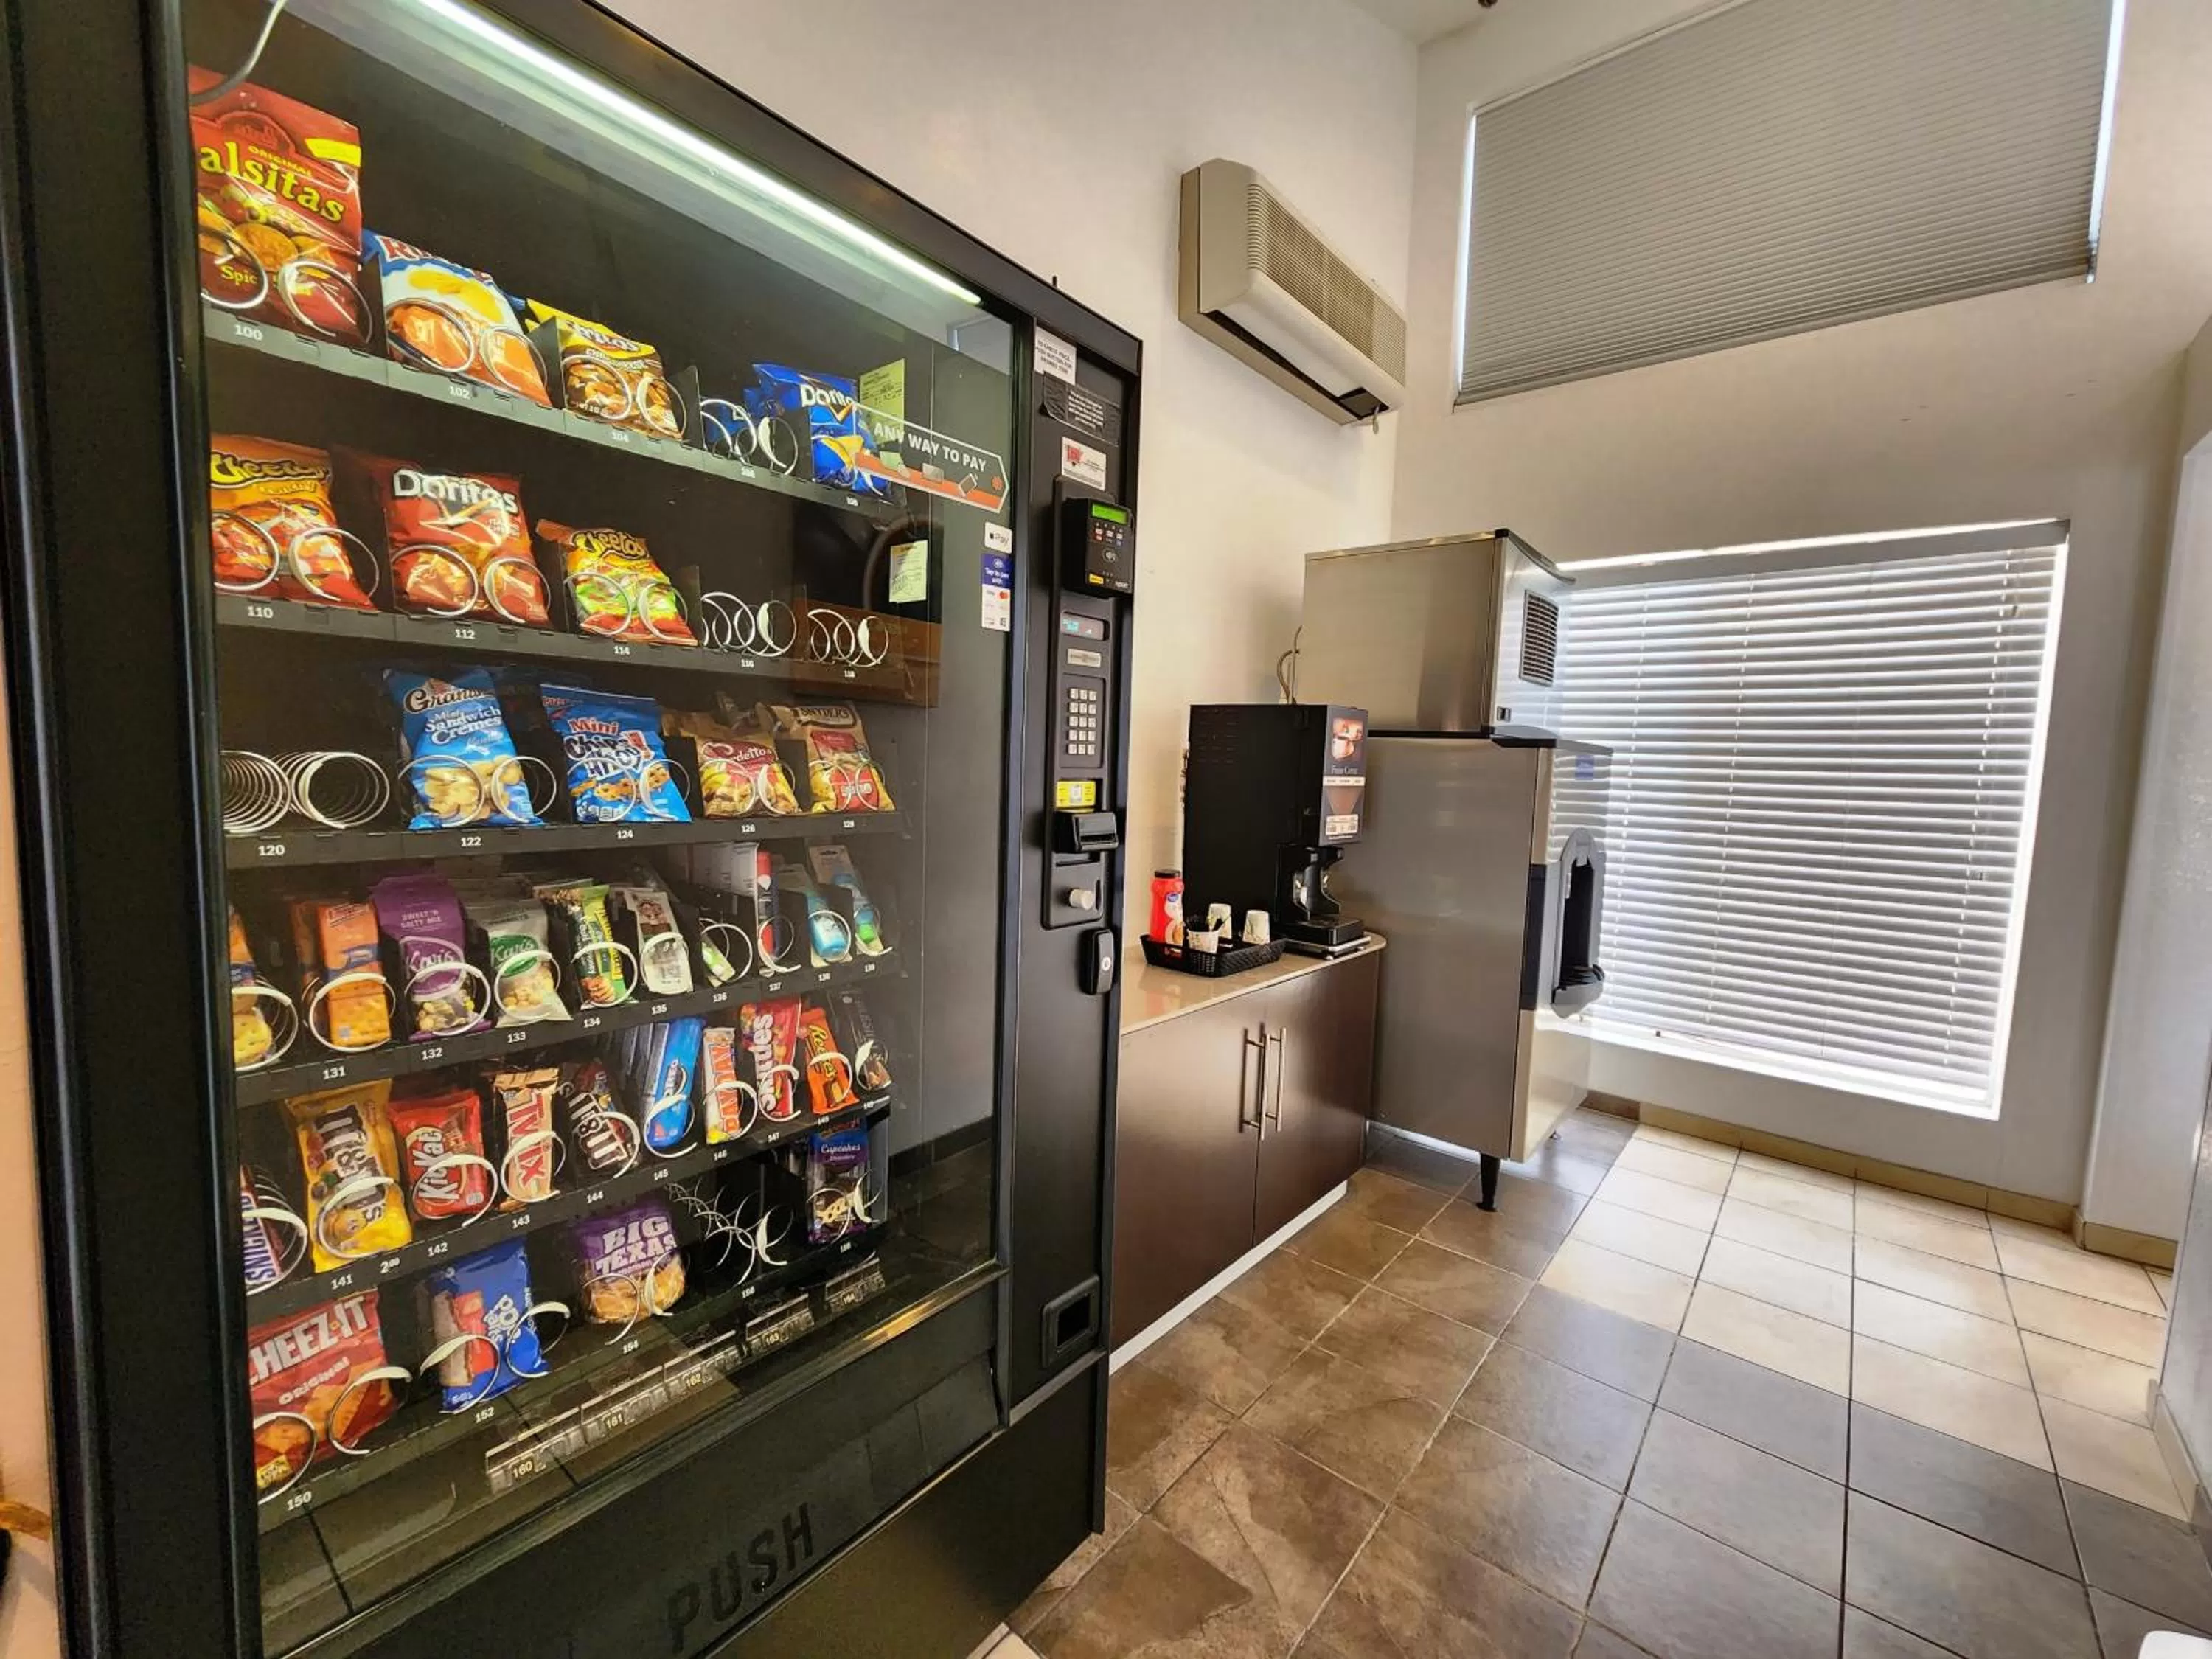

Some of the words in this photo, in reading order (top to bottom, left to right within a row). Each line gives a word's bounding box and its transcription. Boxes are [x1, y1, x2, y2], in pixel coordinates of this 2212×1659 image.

[199, 141, 345, 222] alsitas
[235, 324, 262, 341] 100
[449, 386, 470, 399] 102
[874, 422, 905, 443] ANY
[908, 434, 940, 457] WAY
[942, 446, 959, 462] TO
[963, 455, 987, 472] PAY
[393, 469, 519, 514] Doritos
[573, 531, 646, 560] Cheetos
[247, 605, 273, 619] 110
[455, 629, 476, 640] 112
[613, 645, 630, 655] 114
[425, 706, 502, 732] Sandwich
[568, 717, 619, 735] Mini
[431, 716, 503, 745] Cremes
[461, 836, 481, 846] 122
[617, 830, 634, 839] 124
[258, 844, 286, 856] 120
[651, 1004, 667, 1015] 135
[583, 1016, 601, 1029] 134
[507, 1032, 526, 1044] 133
[422, 1047, 442, 1060] 132
[323, 1066, 346, 1079] 131
[508, 1093, 546, 1186] TWIX
[821, 1143, 861, 1155] Cupcakes
[654, 1169, 669, 1180] 145
[586, 1191, 604, 1204] 144
[512, 1215, 531, 1229] 143
[602, 1216, 669, 1253] BIG
[428, 1242, 448, 1257] 142
[594, 1234, 678, 1275] TEXAS
[331, 1274, 352, 1290] 141
[250, 1296, 368, 1386] HEEZ-IT
[622, 1339, 639, 1354] 154
[686, 1373, 702, 1388] 162
[475, 1406, 495, 1424] 152
[607, 1413, 623, 1428] 161
[512, 1460, 534, 1478] 160
[287, 1491, 313, 1511] 150
[667, 1502, 813, 1656] PUSH
